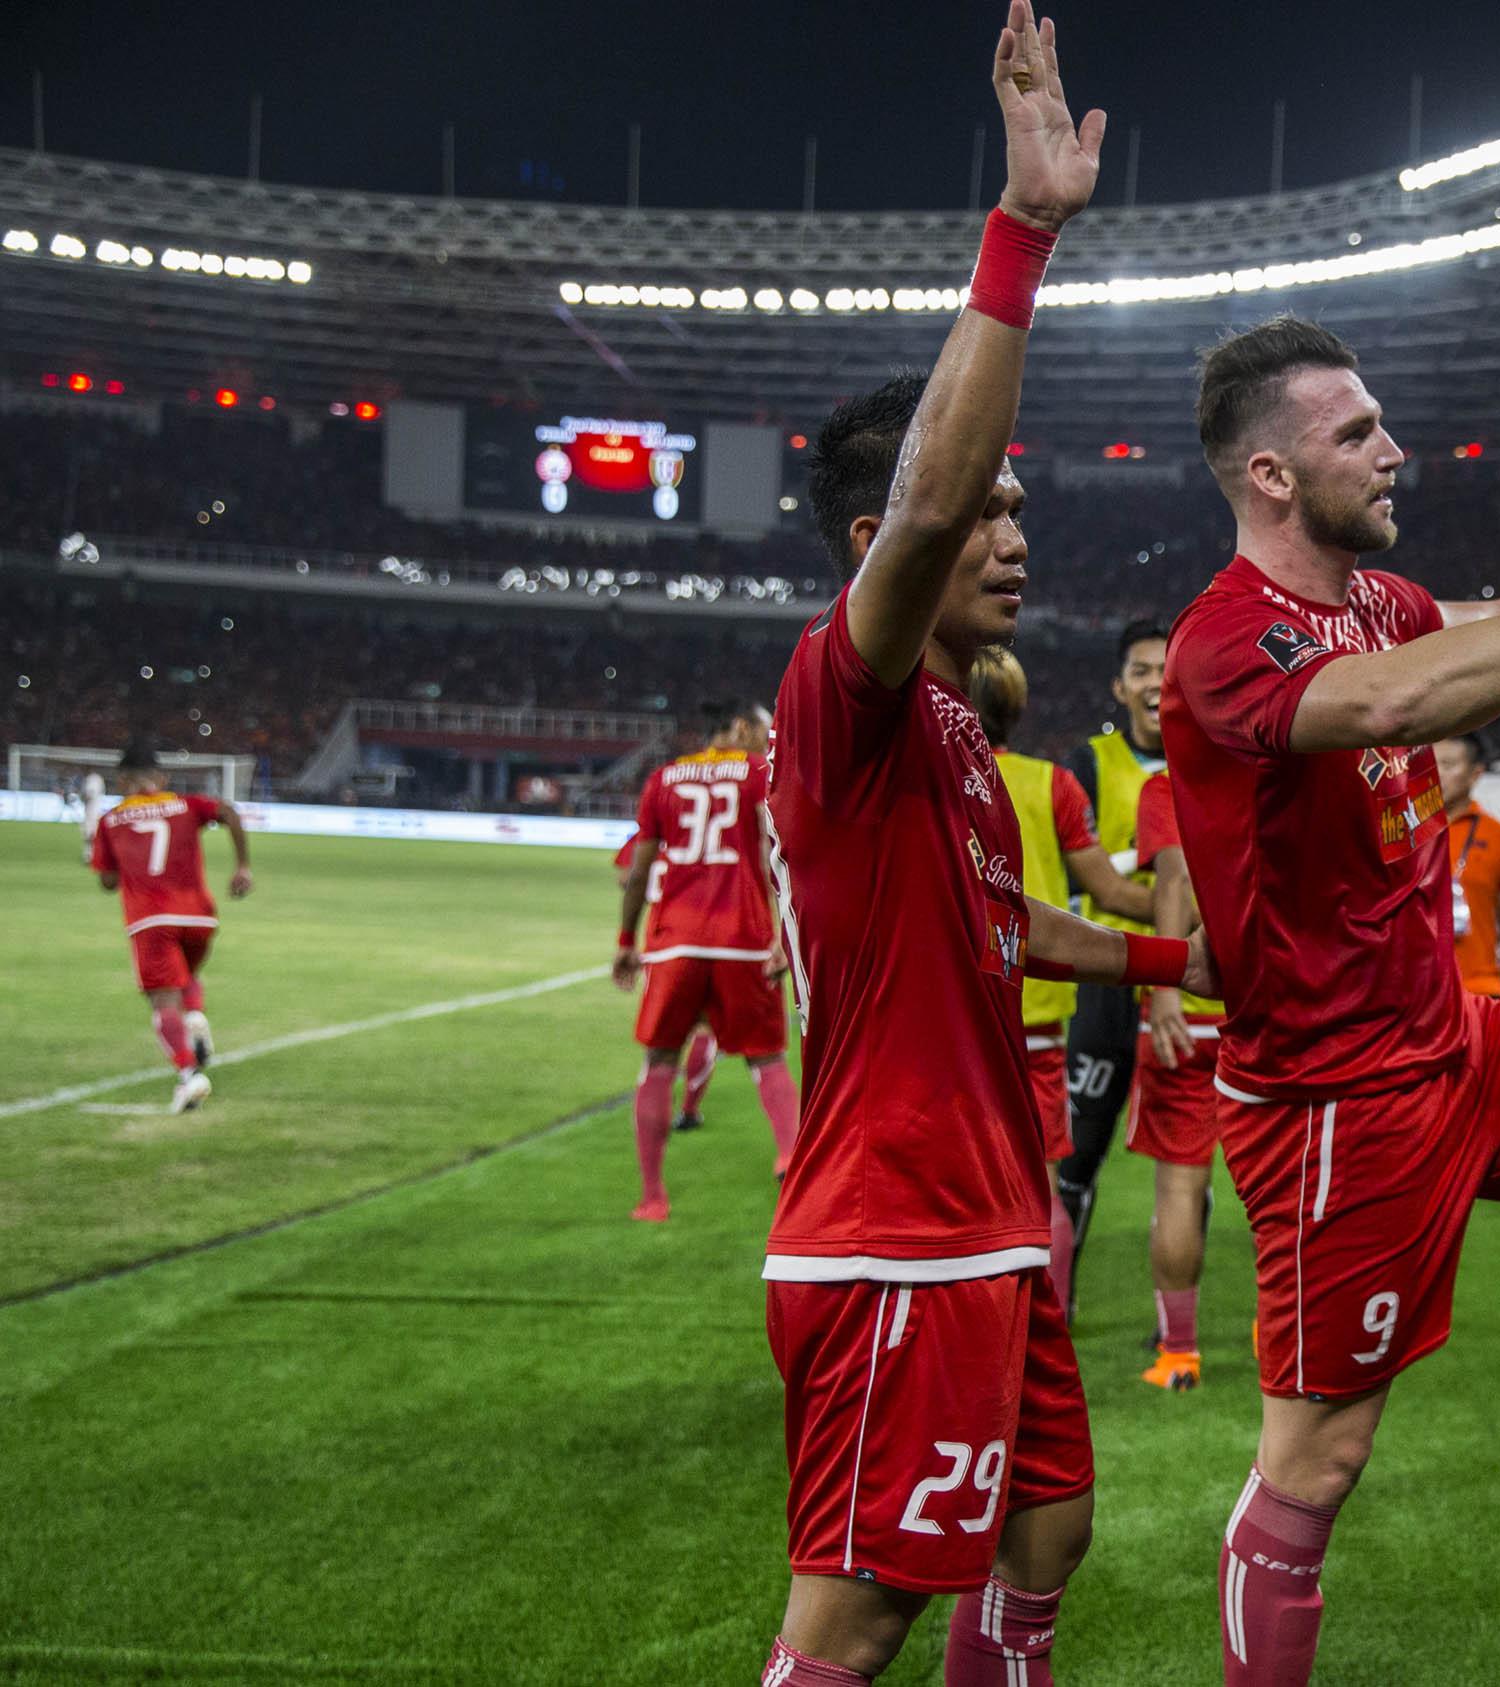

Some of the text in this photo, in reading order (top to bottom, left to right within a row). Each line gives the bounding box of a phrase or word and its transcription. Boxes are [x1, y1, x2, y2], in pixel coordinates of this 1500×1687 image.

[129, 818, 171, 877] 7
[666, 781, 740, 865] 32
[1066, 1052, 1115, 1099] 30
[1351, 1290, 1400, 1365] 9
[899, 1439, 1007, 1536] 29
